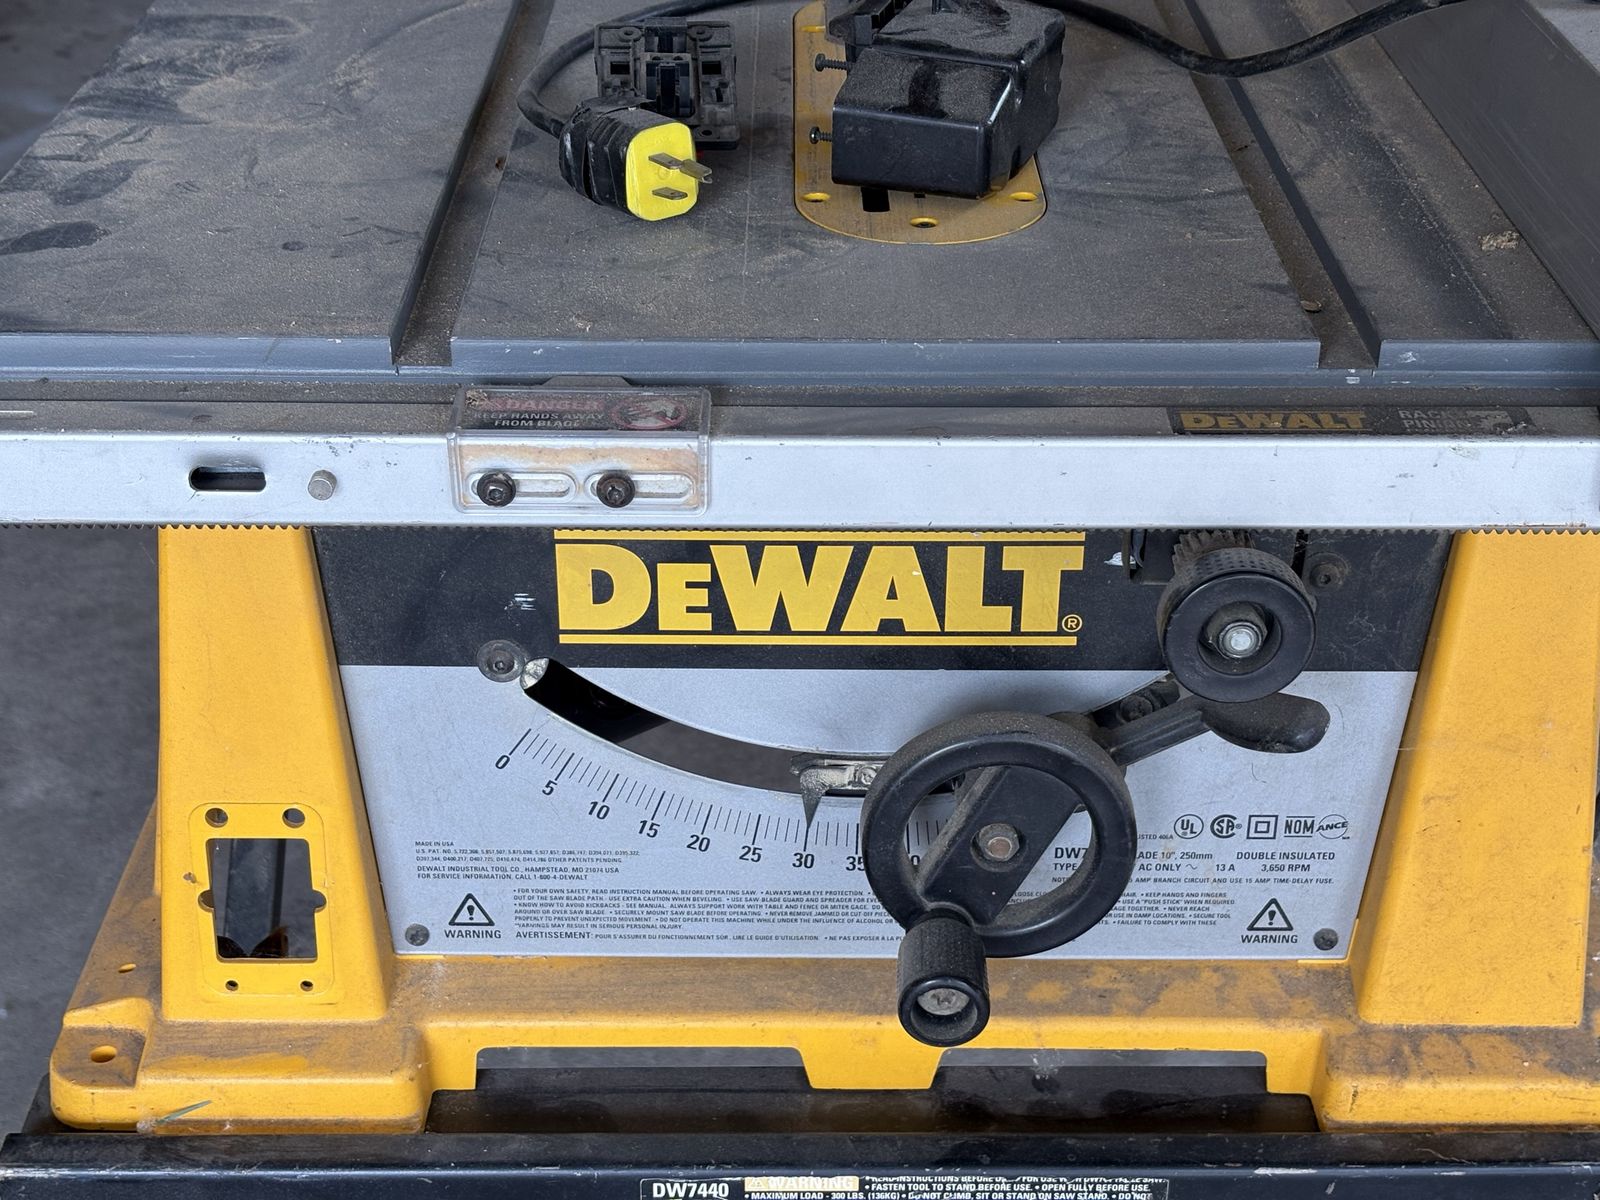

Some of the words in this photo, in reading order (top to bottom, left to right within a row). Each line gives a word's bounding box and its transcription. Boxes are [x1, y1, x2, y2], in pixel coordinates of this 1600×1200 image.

[495, 754, 511, 770] 0
[542, 779, 558, 796] 5
[588, 800, 610, 820] 10
[638, 818, 661, 838] 15
[1284, 818, 1316, 835] NOM
[1316, 821, 1349, 832] ANCE
[686, 834, 711, 852] 20
[738, 844, 763, 863] 25
[792, 852, 815, 869] 30
[1138, 851, 1158, 859] ADE
[1236, 852, 1277, 860] DOUBLE
[1278, 852, 1335, 860] INSULATED
[846, 856, 866, 872] 35
[1052, 862, 1078, 871] TYPE
[1138, 863, 1152, 871] AC
[1154, 863, 1181, 871] ONLY
[1261, 864, 1285, 872] 3,650
[1287, 864, 1310, 872] RPM
[444, 930, 501, 939] WARNING
[1240, 934, 1298, 944] WARNING
[652, 1182, 729, 1198] DW7440
